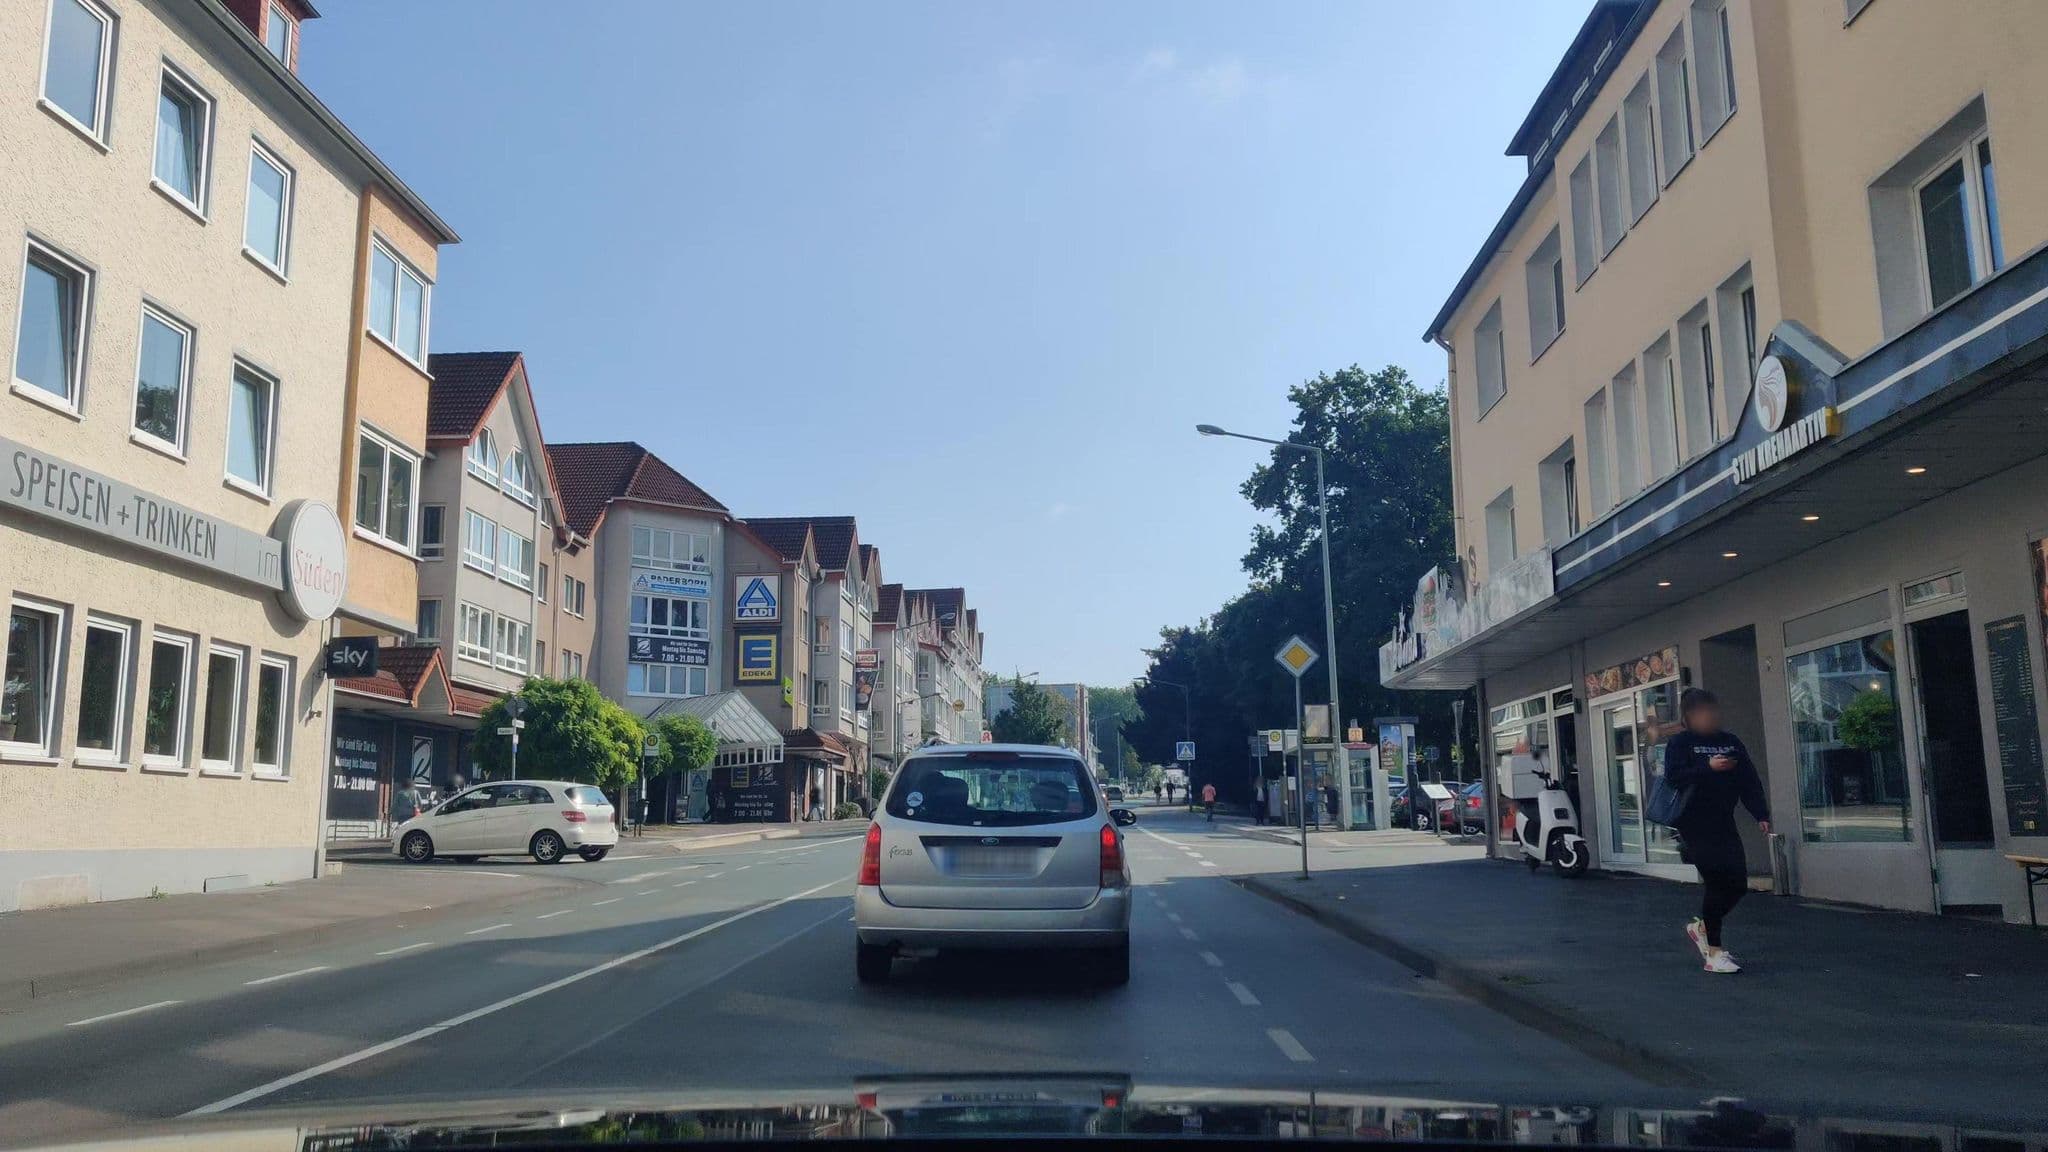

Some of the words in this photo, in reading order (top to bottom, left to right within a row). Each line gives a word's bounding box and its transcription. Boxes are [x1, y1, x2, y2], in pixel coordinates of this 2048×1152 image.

[1732, 447, 1757, 486] STIV
[10, 451, 111, 525] SPEISEN
[133, 495, 217, 560] TRINKEN
[258, 538, 279, 582] im
[294, 549, 341, 597] Süden
[741, 608, 773, 617] ALDI
[332, 646, 368, 668] sky
[661, 653, 675, 662] 7.00
[679, 654, 695, 663] 21.00
[695, 655, 706, 664] Uhr
[334, 775, 347, 790] 7.00
[350, 776, 366, 791] 21.00
[366, 777, 376, 791] Uhr
